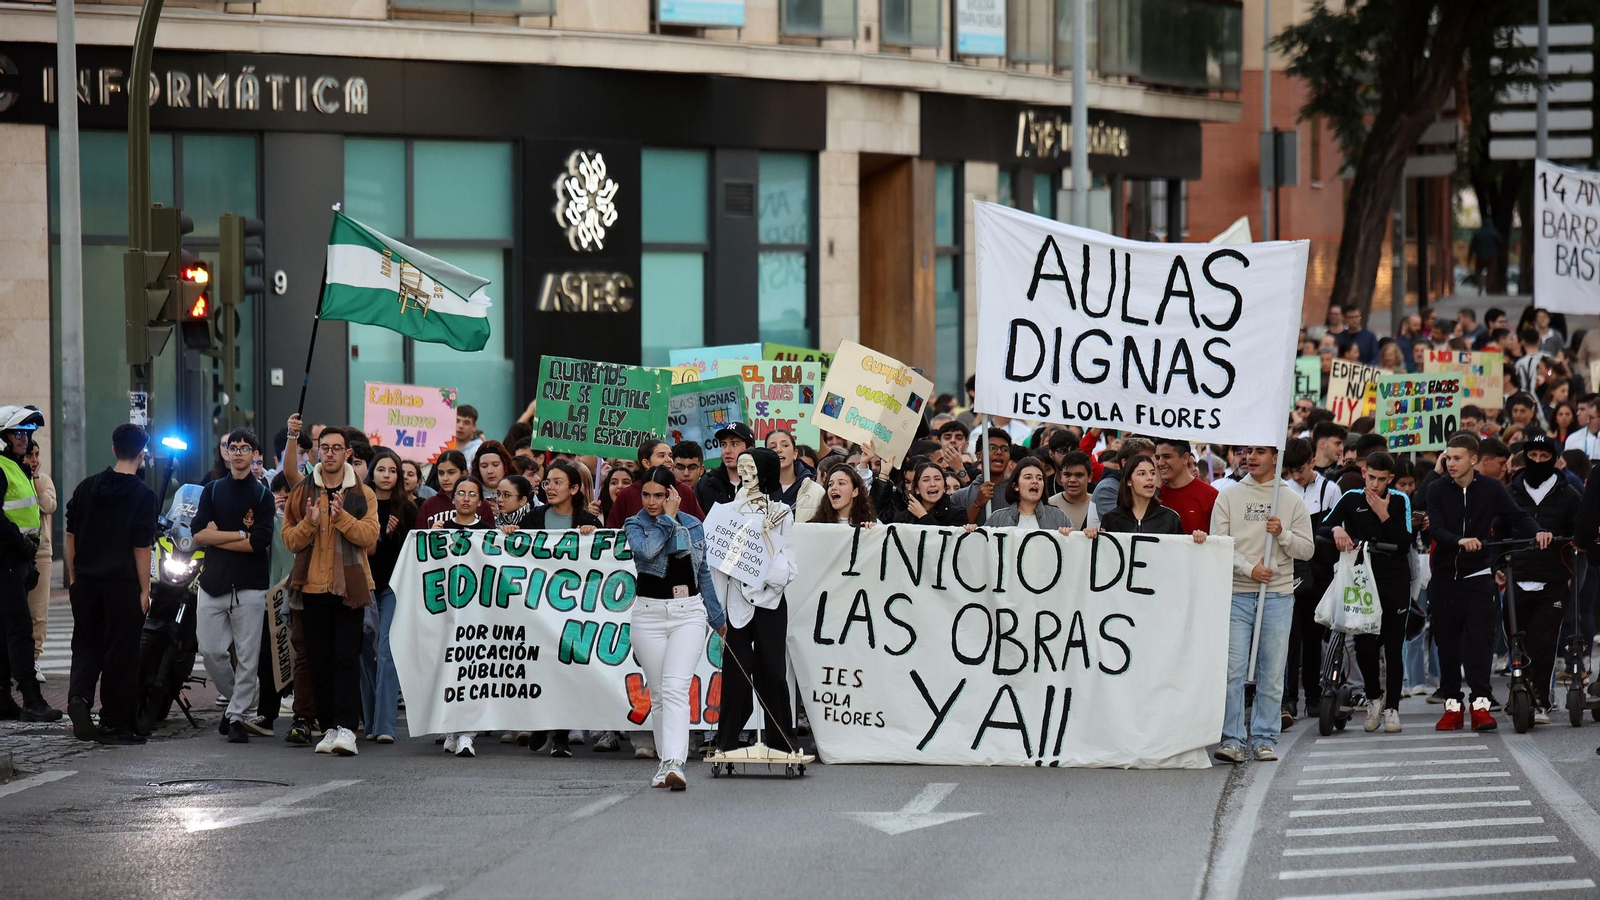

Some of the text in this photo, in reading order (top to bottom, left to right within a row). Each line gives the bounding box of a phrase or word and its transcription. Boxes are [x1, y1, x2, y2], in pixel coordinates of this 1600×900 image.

[1539, 172, 1566, 204] 14
[274, 269, 288, 296] 9
[1026, 234, 1250, 332] AULAS
[1004, 318, 1236, 400] DIGNAS
[549, 360, 628, 387] QUEREMOS
[741, 364, 764, 382] EL
[772, 365, 803, 383] LOLA
[369, 387, 424, 408] Edificio
[542, 382, 651, 411] QUE SE CUMPLE
[751, 383, 794, 400] FLORES
[388, 408, 437, 428] Nuevo
[567, 403, 628, 428] LA LEY
[755, 401, 769, 417] SE
[1013, 392, 1221, 430] IES LOLA FLORES
[540, 420, 588, 443] AULAS
[1429, 414, 1457, 445] NO
[714, 524, 764, 554] ESPERANDO
[728, 519, 761, 540] 14 AÑOS
[416, 529, 473, 563] IES
[482, 529, 580, 561] LOLA
[705, 532, 763, 567] LA EDUCACIÓN
[710, 547, 727, 561] LOS
[726, 555, 761, 578] HUESOS
[841, 525, 1160, 595] INICIO DE
[422, 563, 637, 615] EDIFICIO
[455, 624, 526, 642] POR UNA
[813, 588, 1136, 676] LAS OBRAS
[444, 641, 540, 663] EDUCACIÓN
[457, 659, 526, 682] PÚBLICA
[821, 666, 864, 689] IES
[443, 682, 542, 704] DE CALIDAD
[812, 690, 850, 709] LOLA
[824, 706, 886, 728] FLORES
[909, 669, 1073, 768] YA!!
